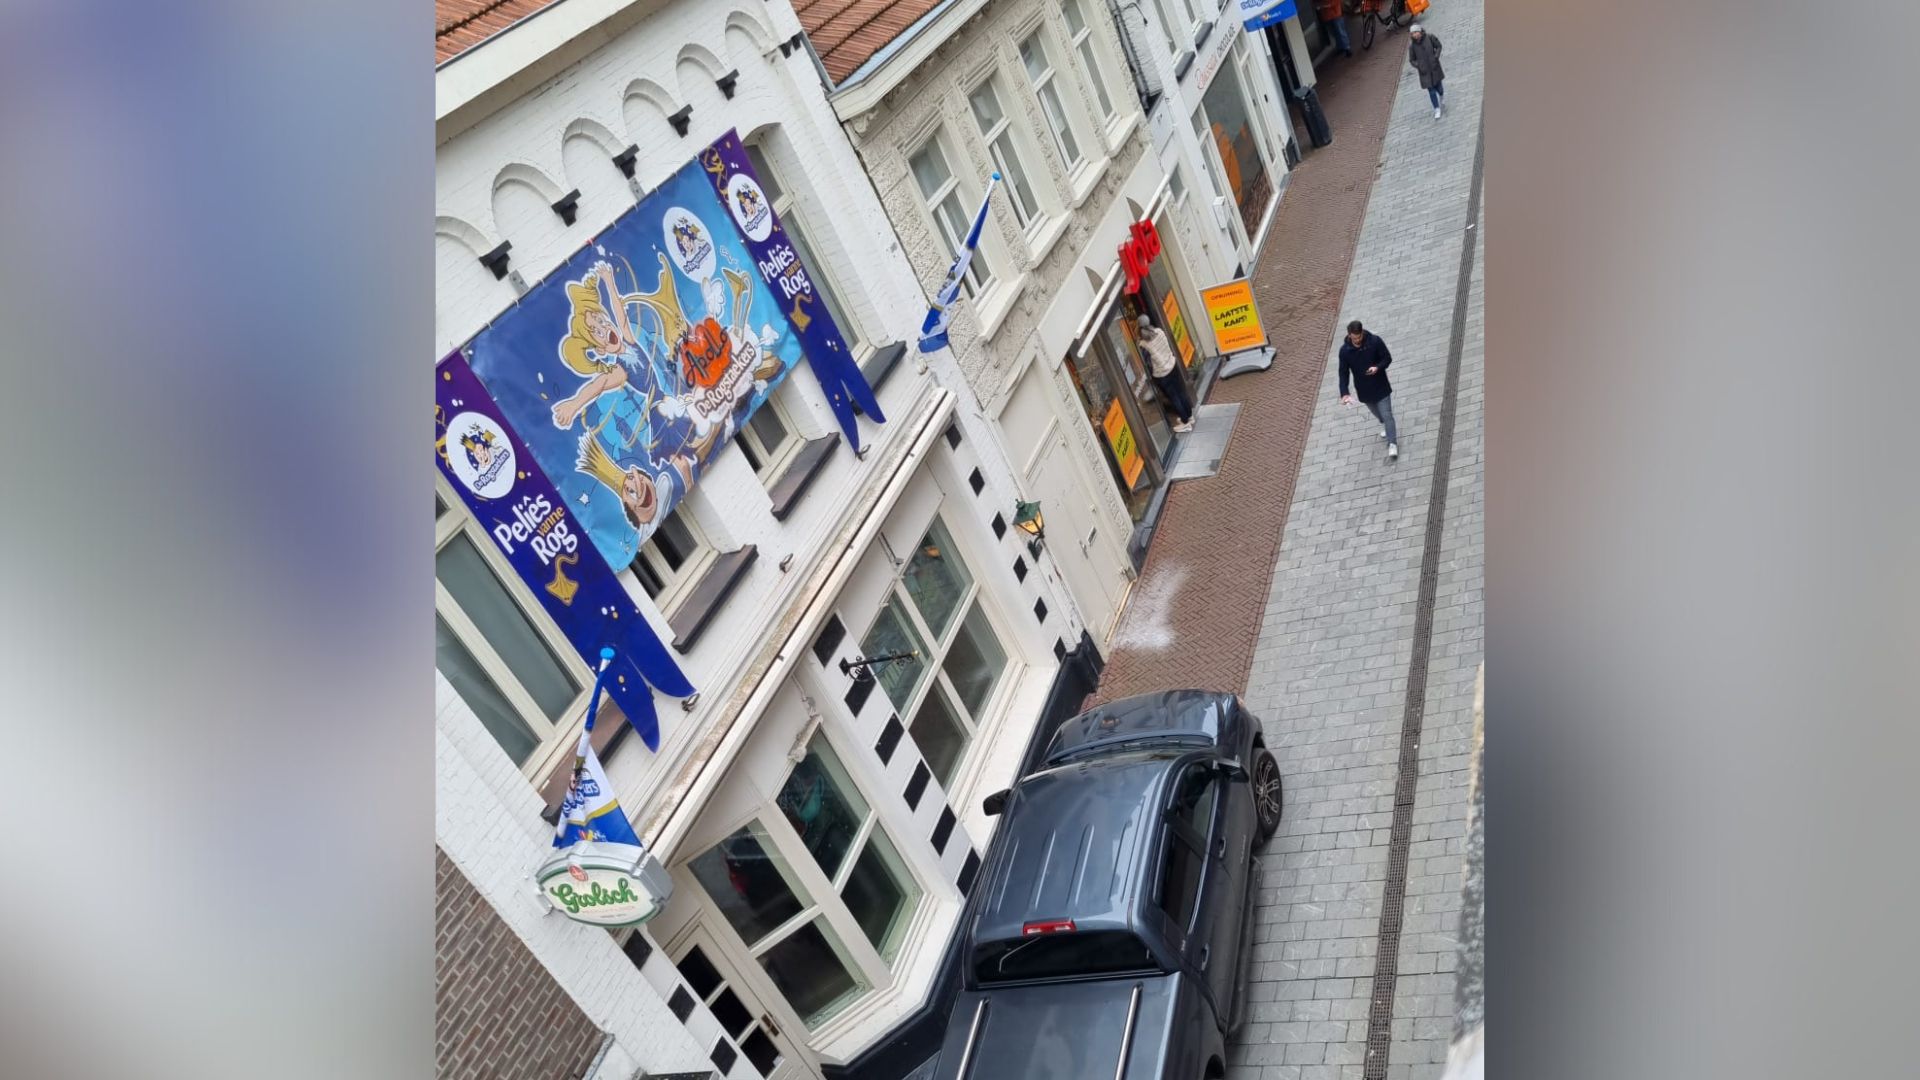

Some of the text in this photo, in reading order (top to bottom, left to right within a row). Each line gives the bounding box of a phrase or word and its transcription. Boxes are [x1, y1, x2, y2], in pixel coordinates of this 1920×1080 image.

[758, 244, 795, 284] Peliês
[778, 268, 811, 300] Rog
[1215, 304, 1249, 321] LAATSTE
[493, 494, 552, 554] Peliês
[537, 506, 565, 537] vanne
[530, 519, 578, 566] Rog
[550, 878, 638, 914] Grolsch
